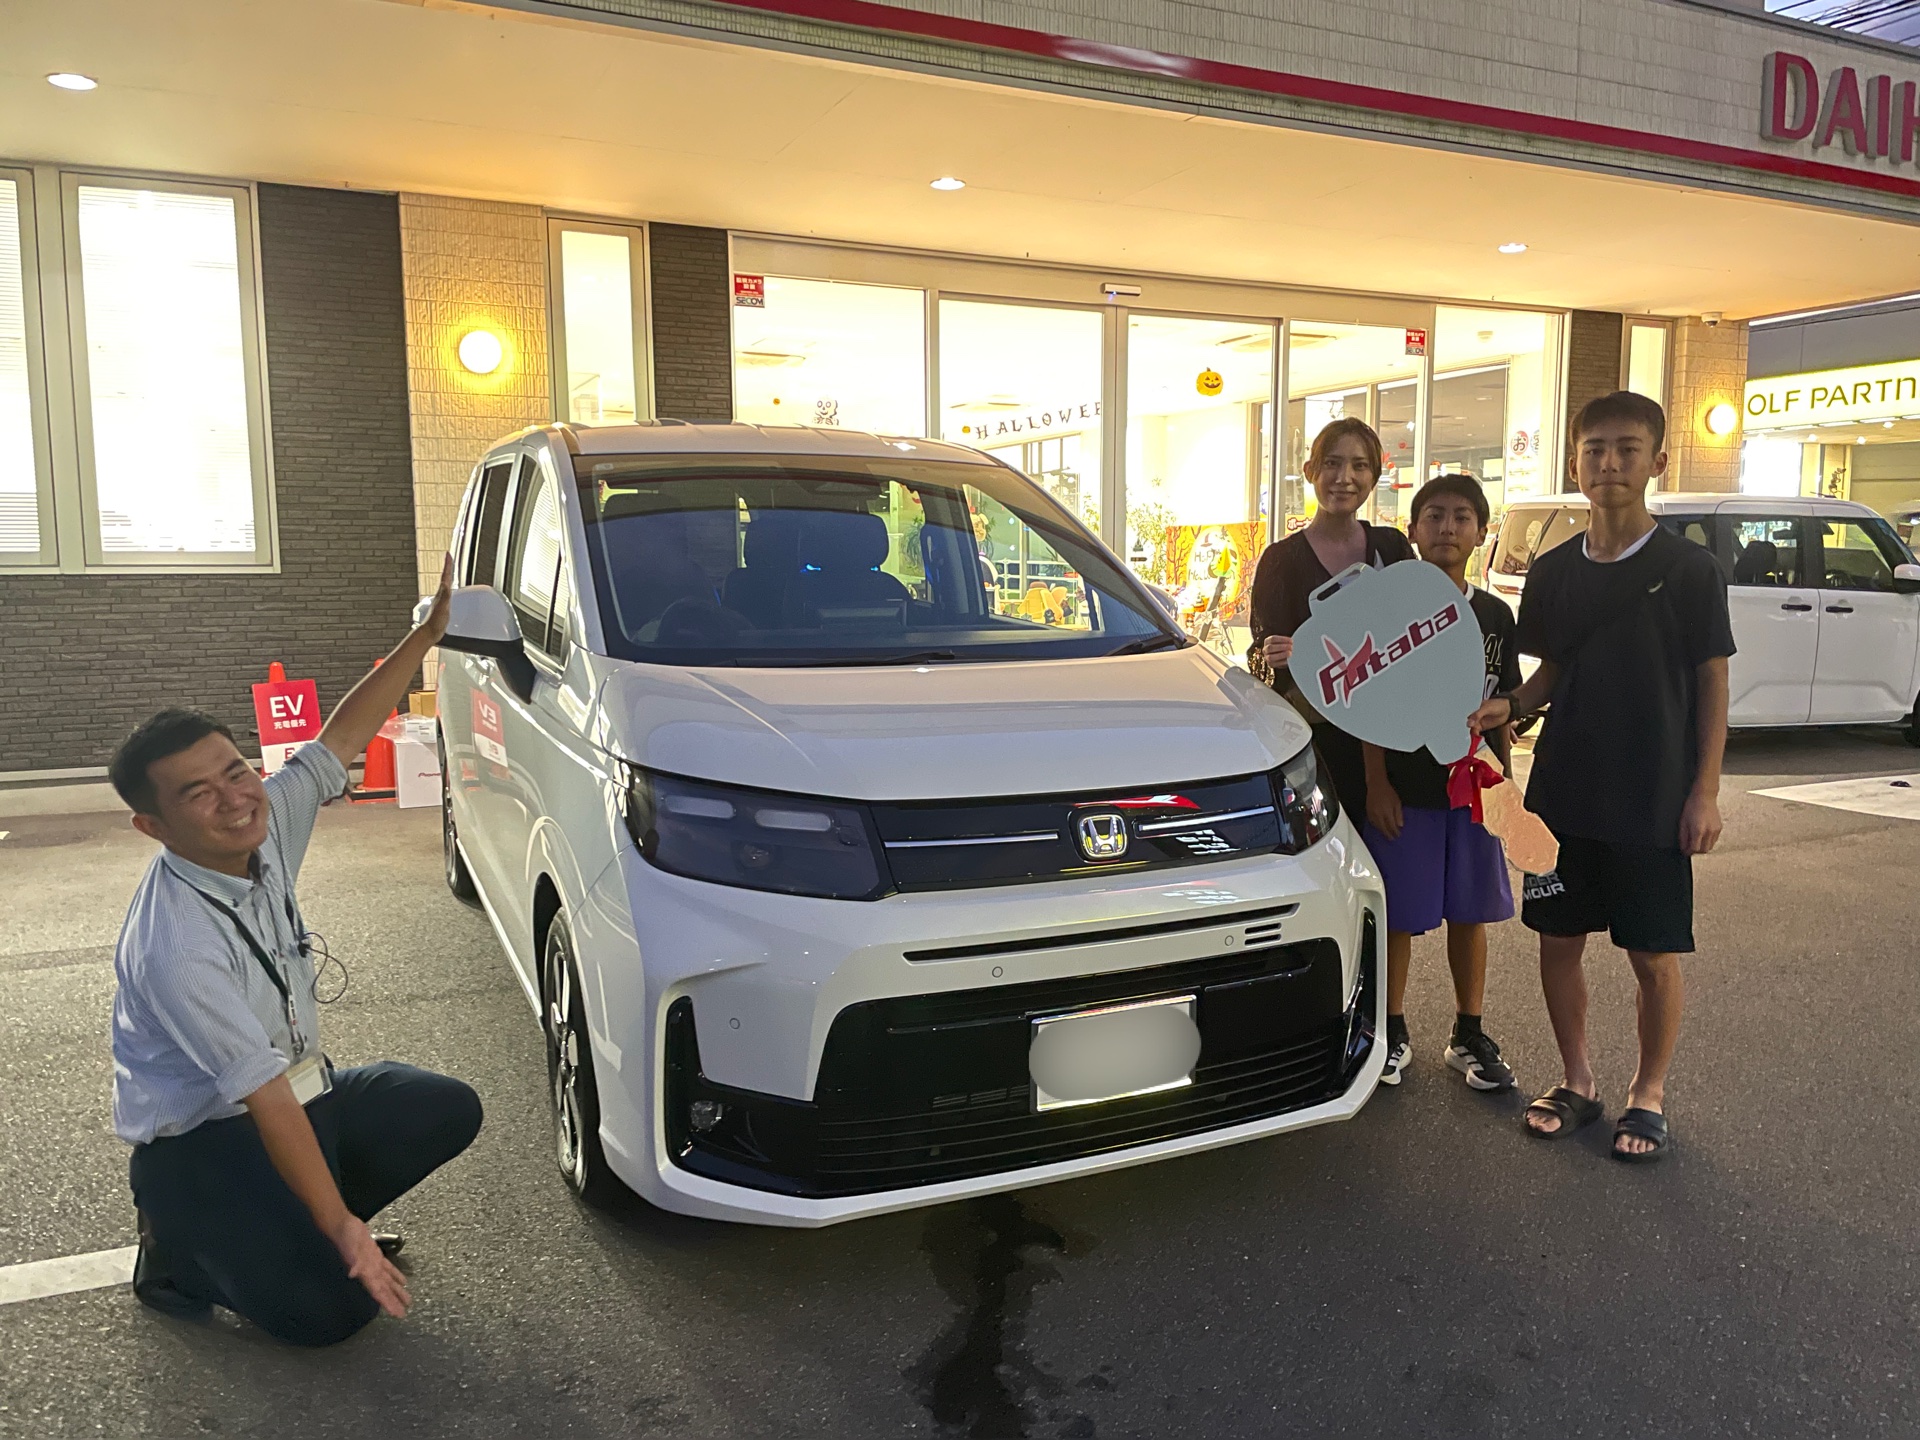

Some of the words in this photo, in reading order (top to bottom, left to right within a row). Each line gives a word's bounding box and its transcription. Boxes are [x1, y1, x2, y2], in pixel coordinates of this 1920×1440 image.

[736, 296, 763, 305] SECOM
[1747, 389, 1801, 416] OLF
[1319, 603, 1459, 705] Futaba
[269, 694, 304, 718] EV
